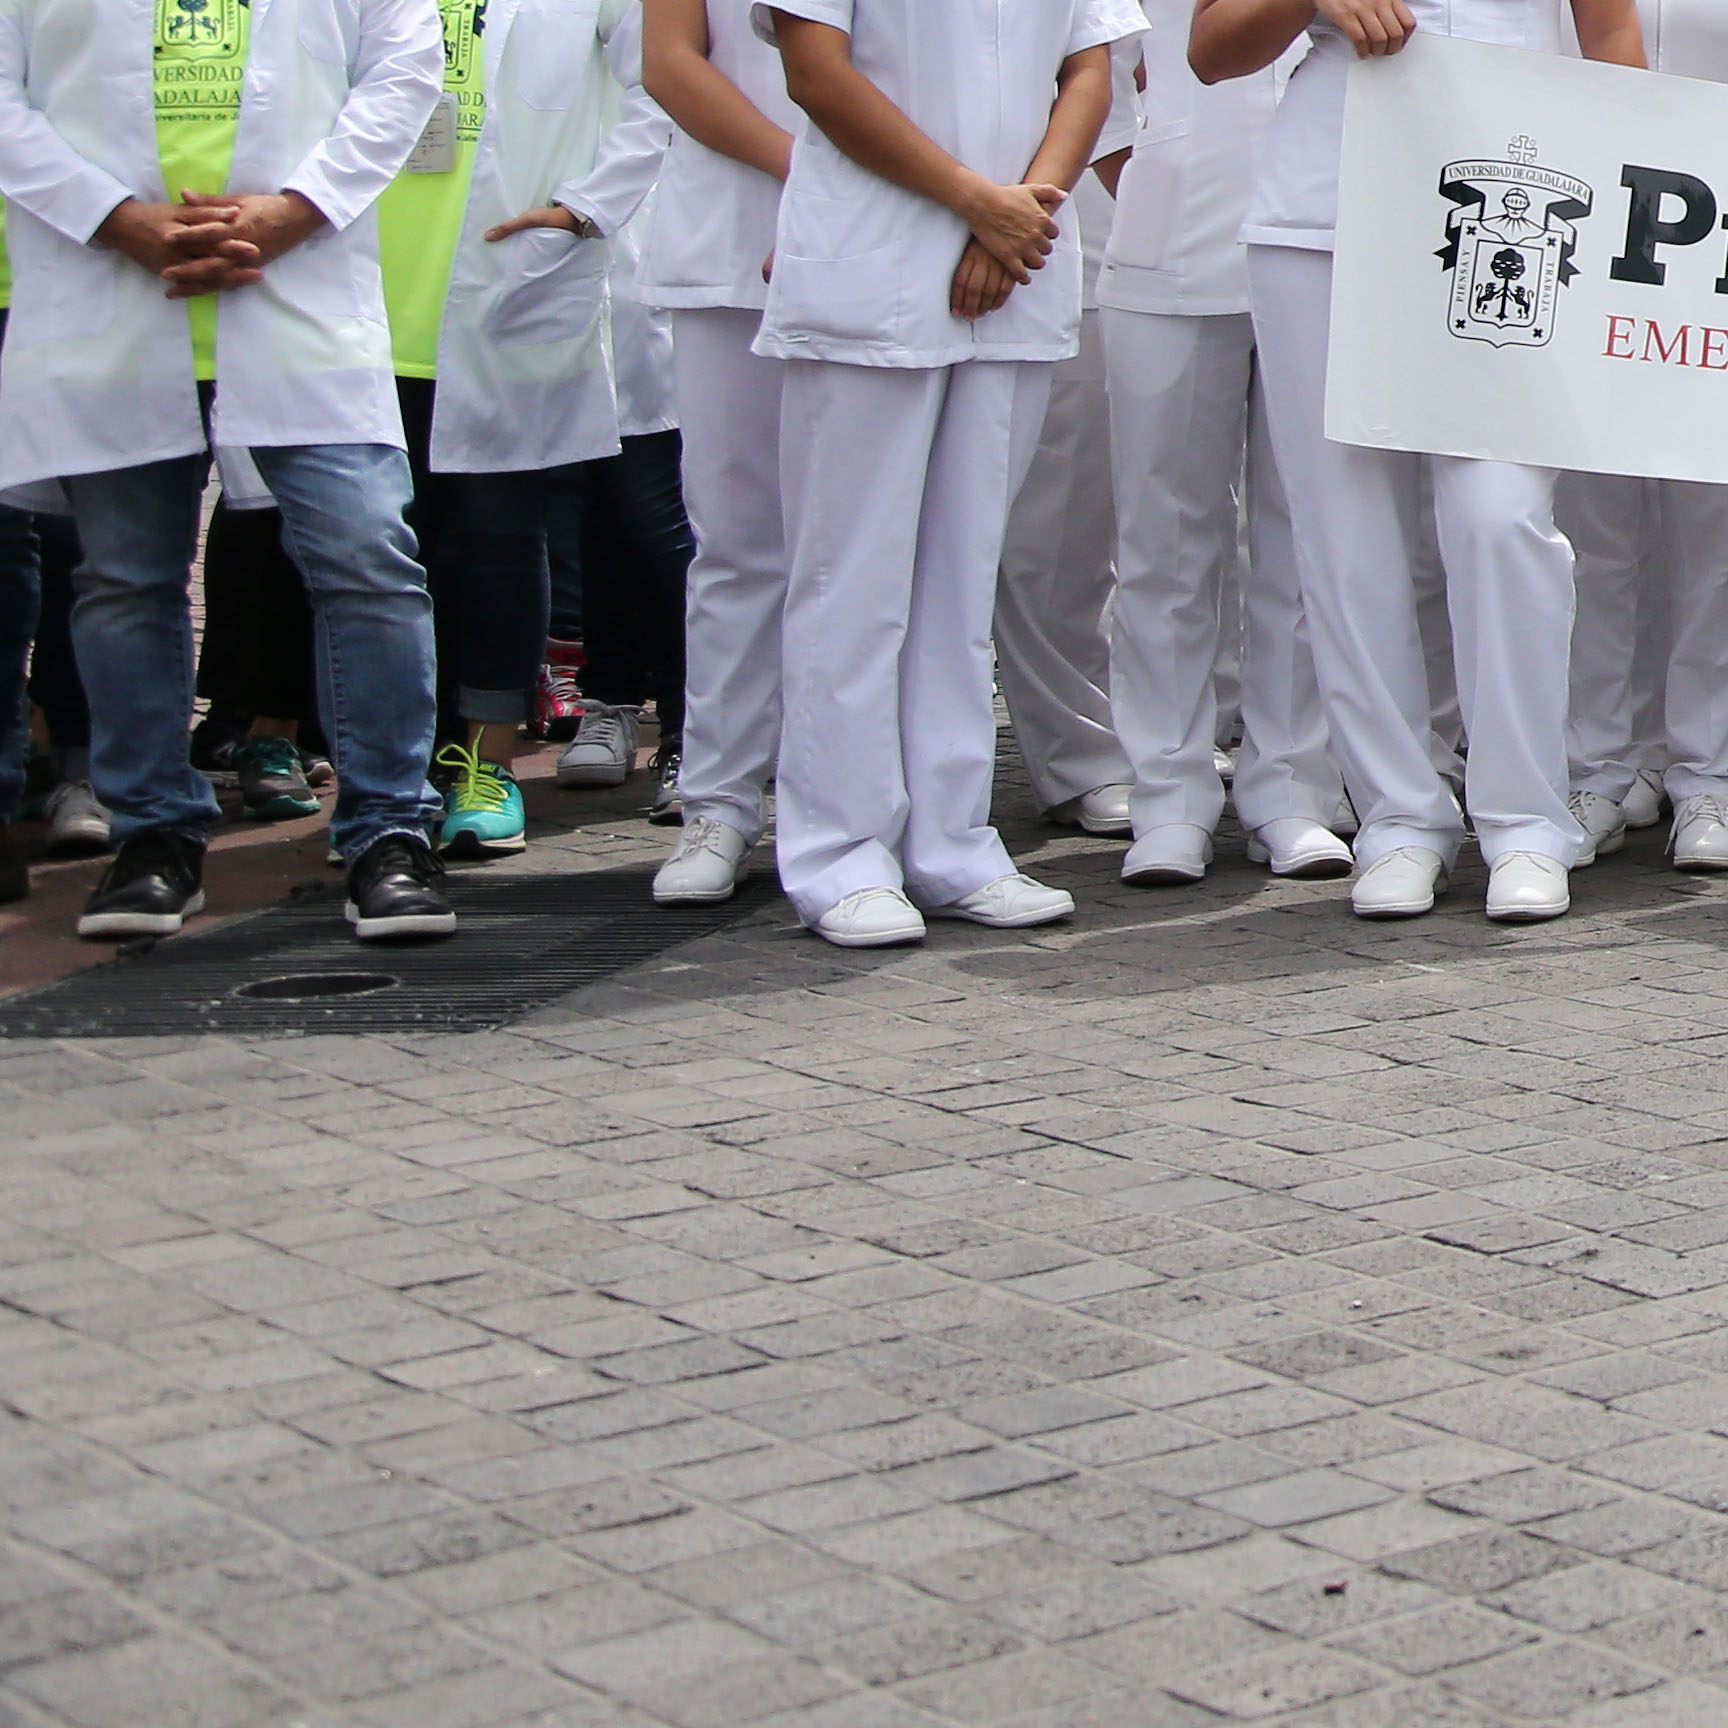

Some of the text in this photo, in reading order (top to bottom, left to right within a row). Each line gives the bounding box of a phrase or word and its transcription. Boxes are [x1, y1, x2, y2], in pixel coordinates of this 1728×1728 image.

[153, 64, 243, 82] VERSIDAD
[153, 88, 241, 104] ADALAJA
[1448, 164, 1588, 200] UNIVERSIDAD DE GUADALAJARA
[1455, 260, 1469, 303] PIENSA
[1541, 262, 1555, 313] TRABAJA
